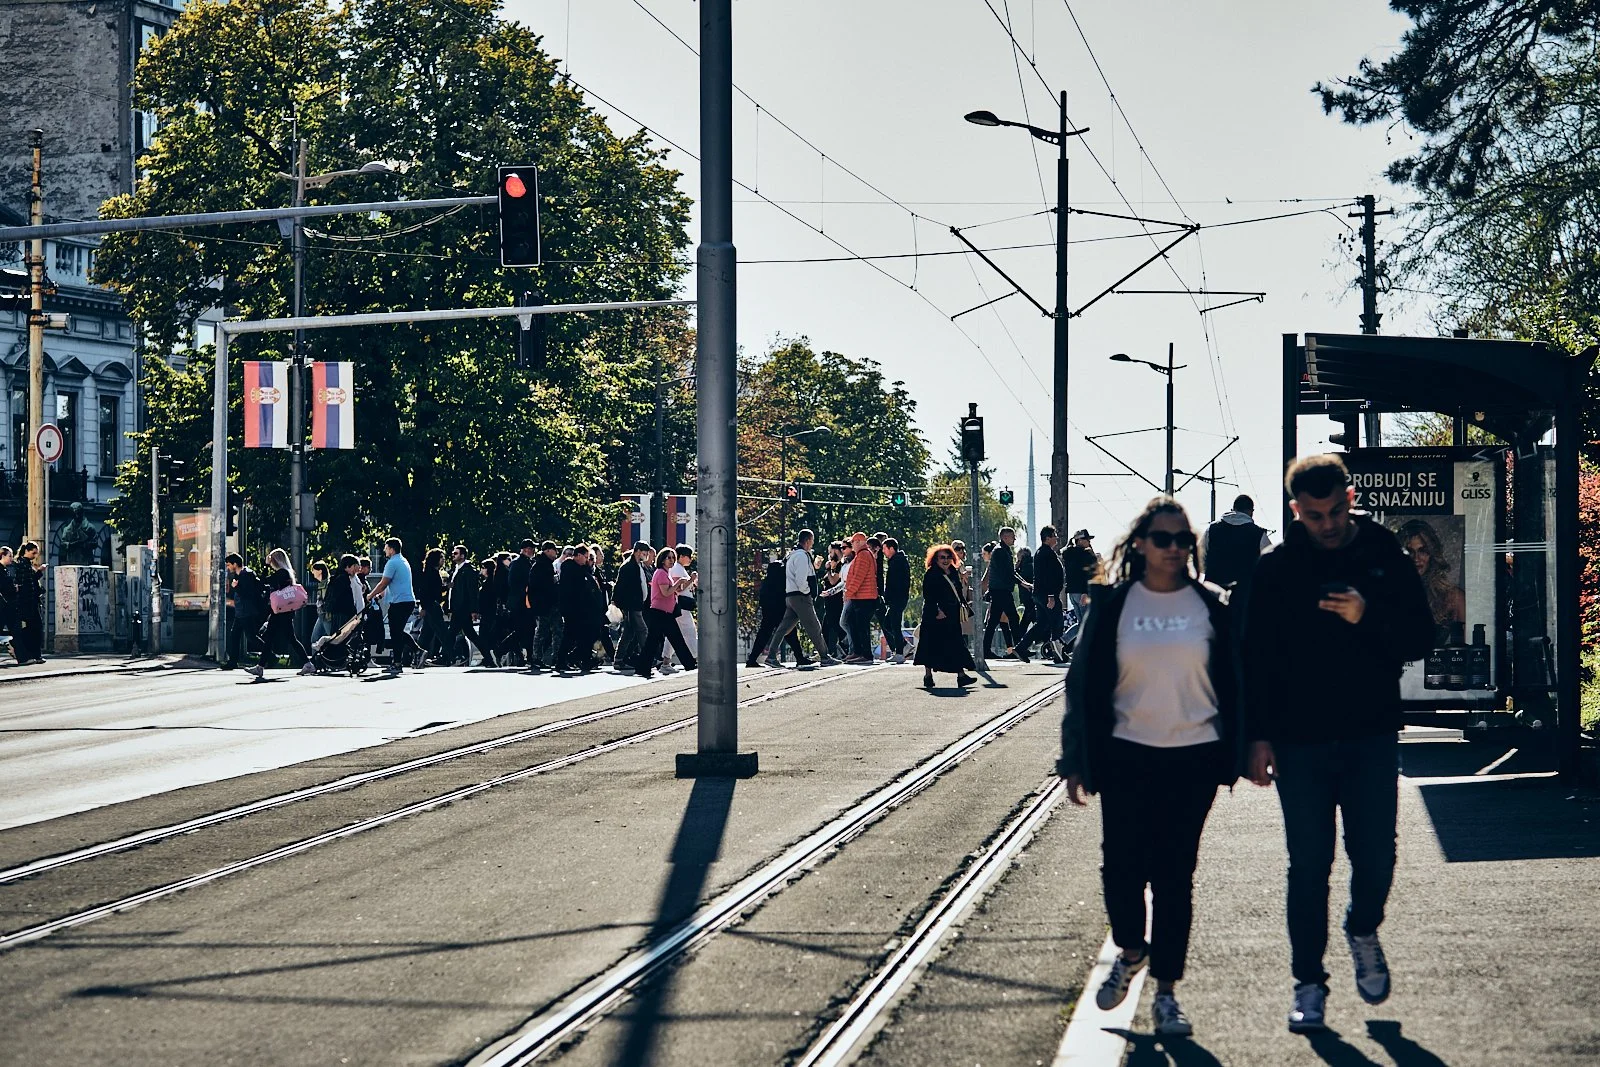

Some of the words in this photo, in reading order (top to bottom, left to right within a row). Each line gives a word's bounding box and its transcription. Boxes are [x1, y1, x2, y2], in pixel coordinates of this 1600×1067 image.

[1417, 472, 1437, 487] SE
[1368, 488, 1445, 507] SNAŽNIJU
[1461, 488, 1491, 499] GLISS
